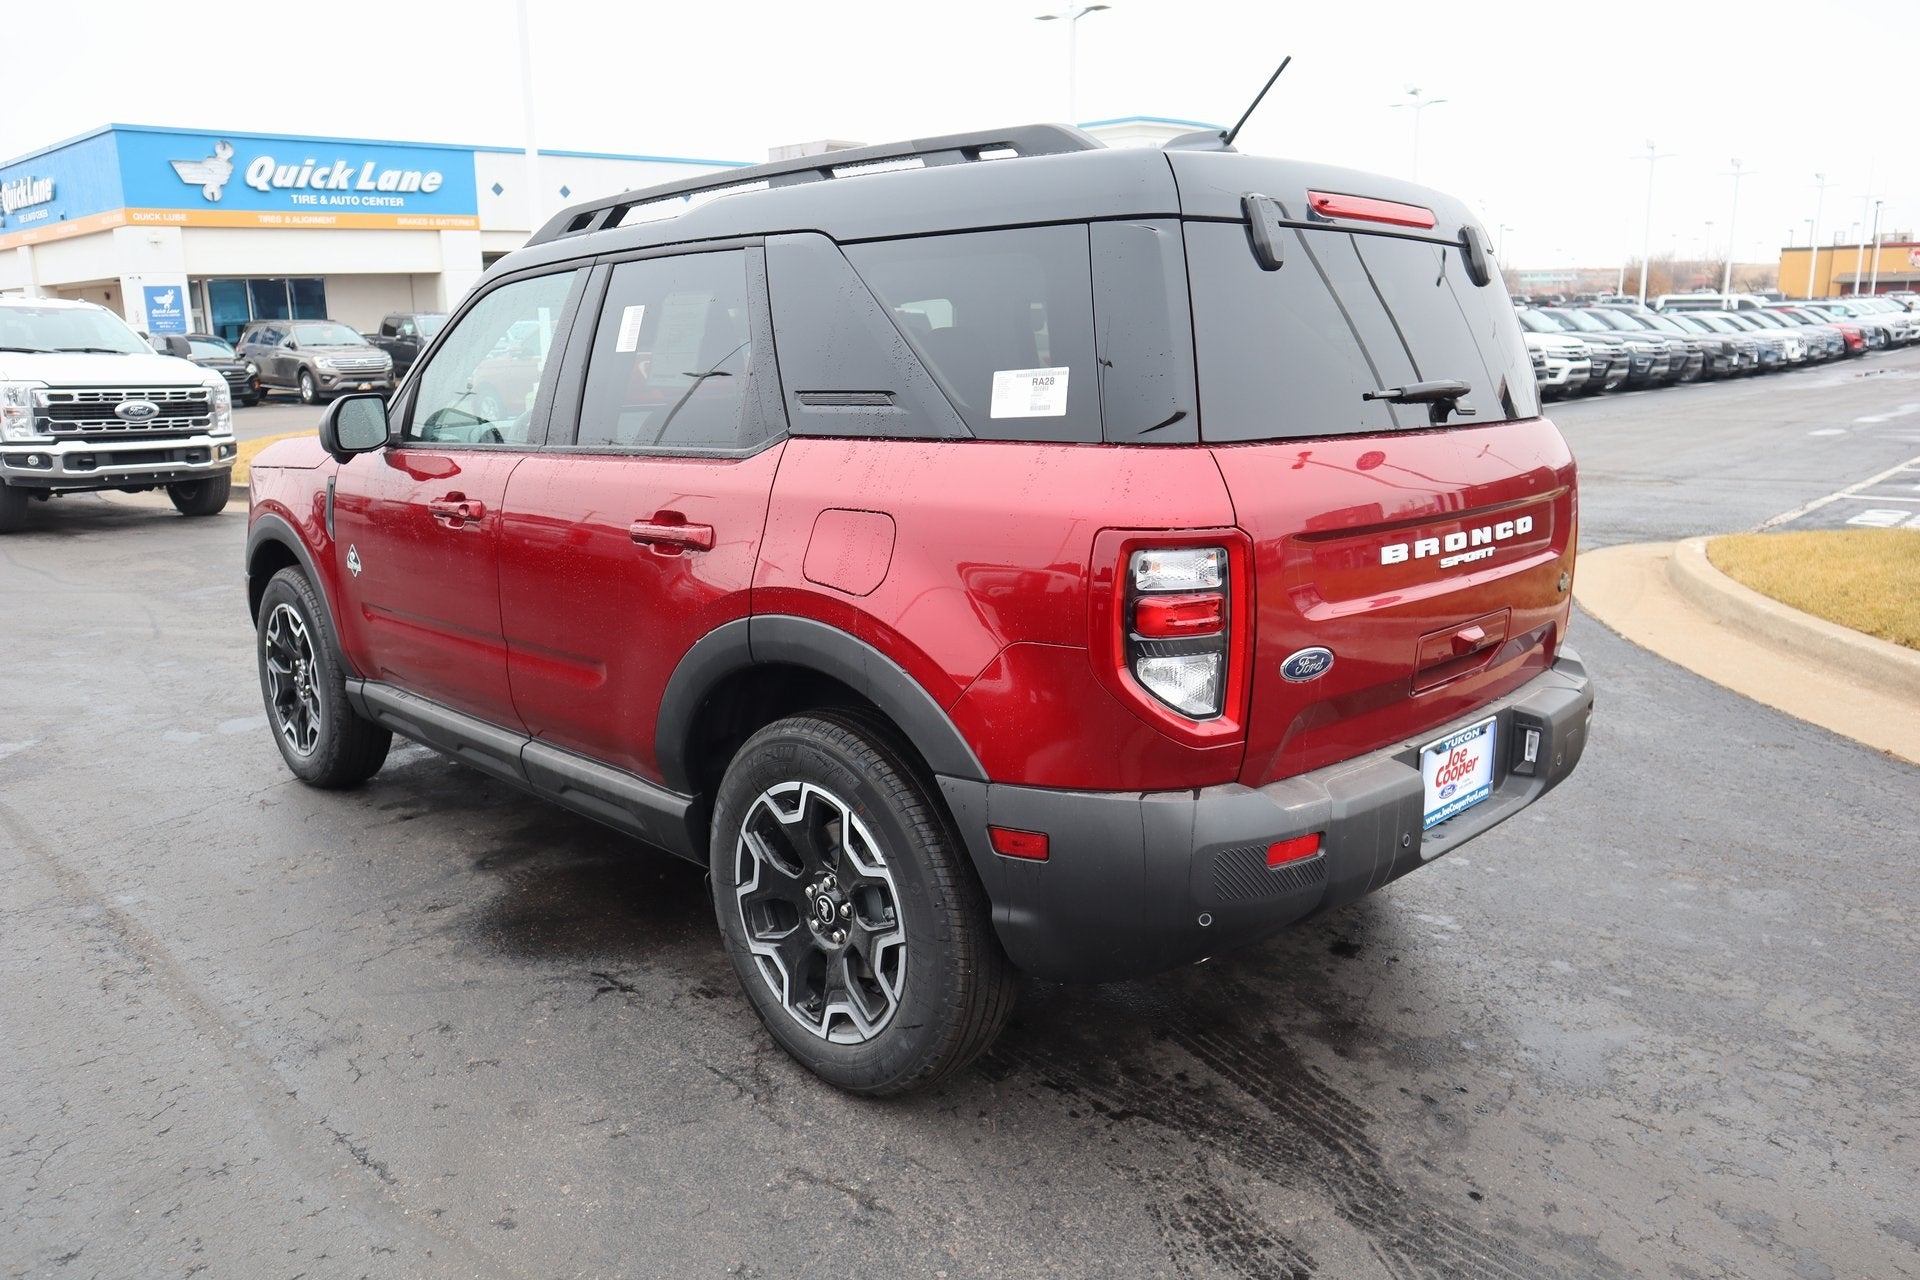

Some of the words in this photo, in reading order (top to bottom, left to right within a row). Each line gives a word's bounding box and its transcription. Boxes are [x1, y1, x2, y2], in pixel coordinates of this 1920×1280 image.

[245, 155, 354, 192] Quick
[354, 161, 443, 193] Lane
[2, 178, 27, 214] Quick
[26, 175, 55, 204] Lane
[291, 194, 317, 204] TIRE
[320, 195, 328, 205] &
[329, 196, 360, 206] AUTO
[361, 197, 405, 207] CENTER
[132, 212, 161, 221] QUICK
[163, 213, 187, 222] LUBE
[257, 215, 282, 224] TIRES
[291, 216, 336, 225] ALIGNMENT
[1032, 377, 1055, 386] RA28
[1381, 516, 1533, 565] BRONCO
[1440, 546, 1496, 569] SPORT
[1295, 655, 1325, 676] Ford
[1444, 727, 1481, 750] YUKON
[1445, 748, 1468, 771] Joe
[1435, 756, 1479, 788] Cooper
